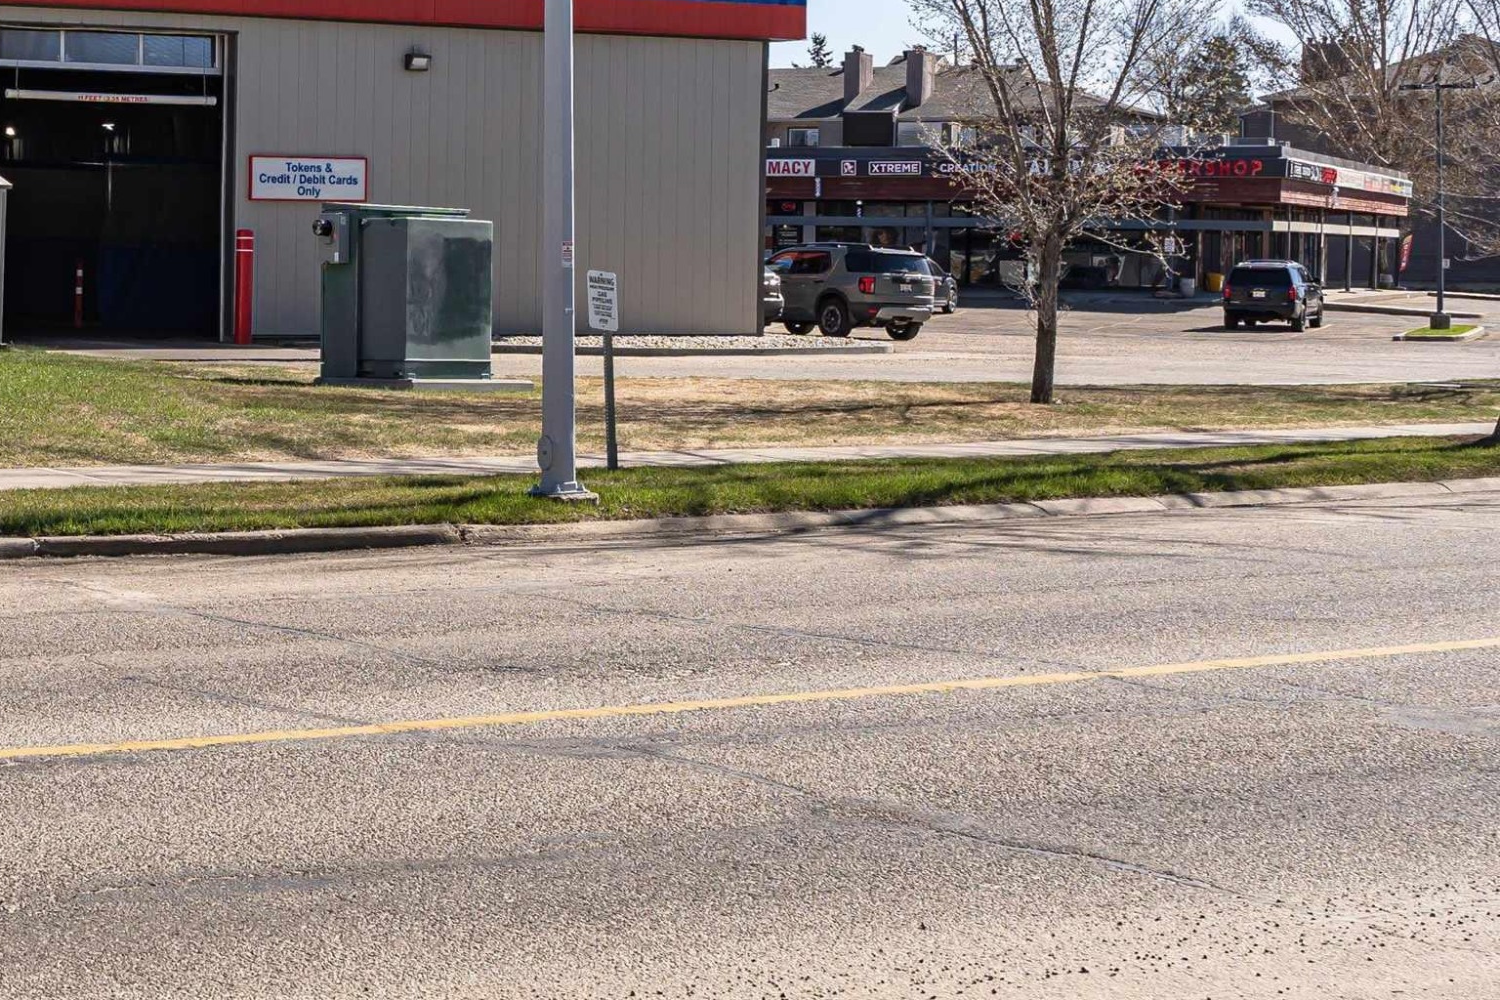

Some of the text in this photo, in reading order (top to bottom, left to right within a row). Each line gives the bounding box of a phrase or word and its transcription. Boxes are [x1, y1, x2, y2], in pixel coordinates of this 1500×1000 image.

[286, 162, 333, 173] Tokens &
[871, 163, 919, 173] XTREME
[260, 173, 290, 184] Credit
[300, 174, 325, 184] Debit
[329, 175, 358, 185] Cards
[297, 186, 320, 198] Only
